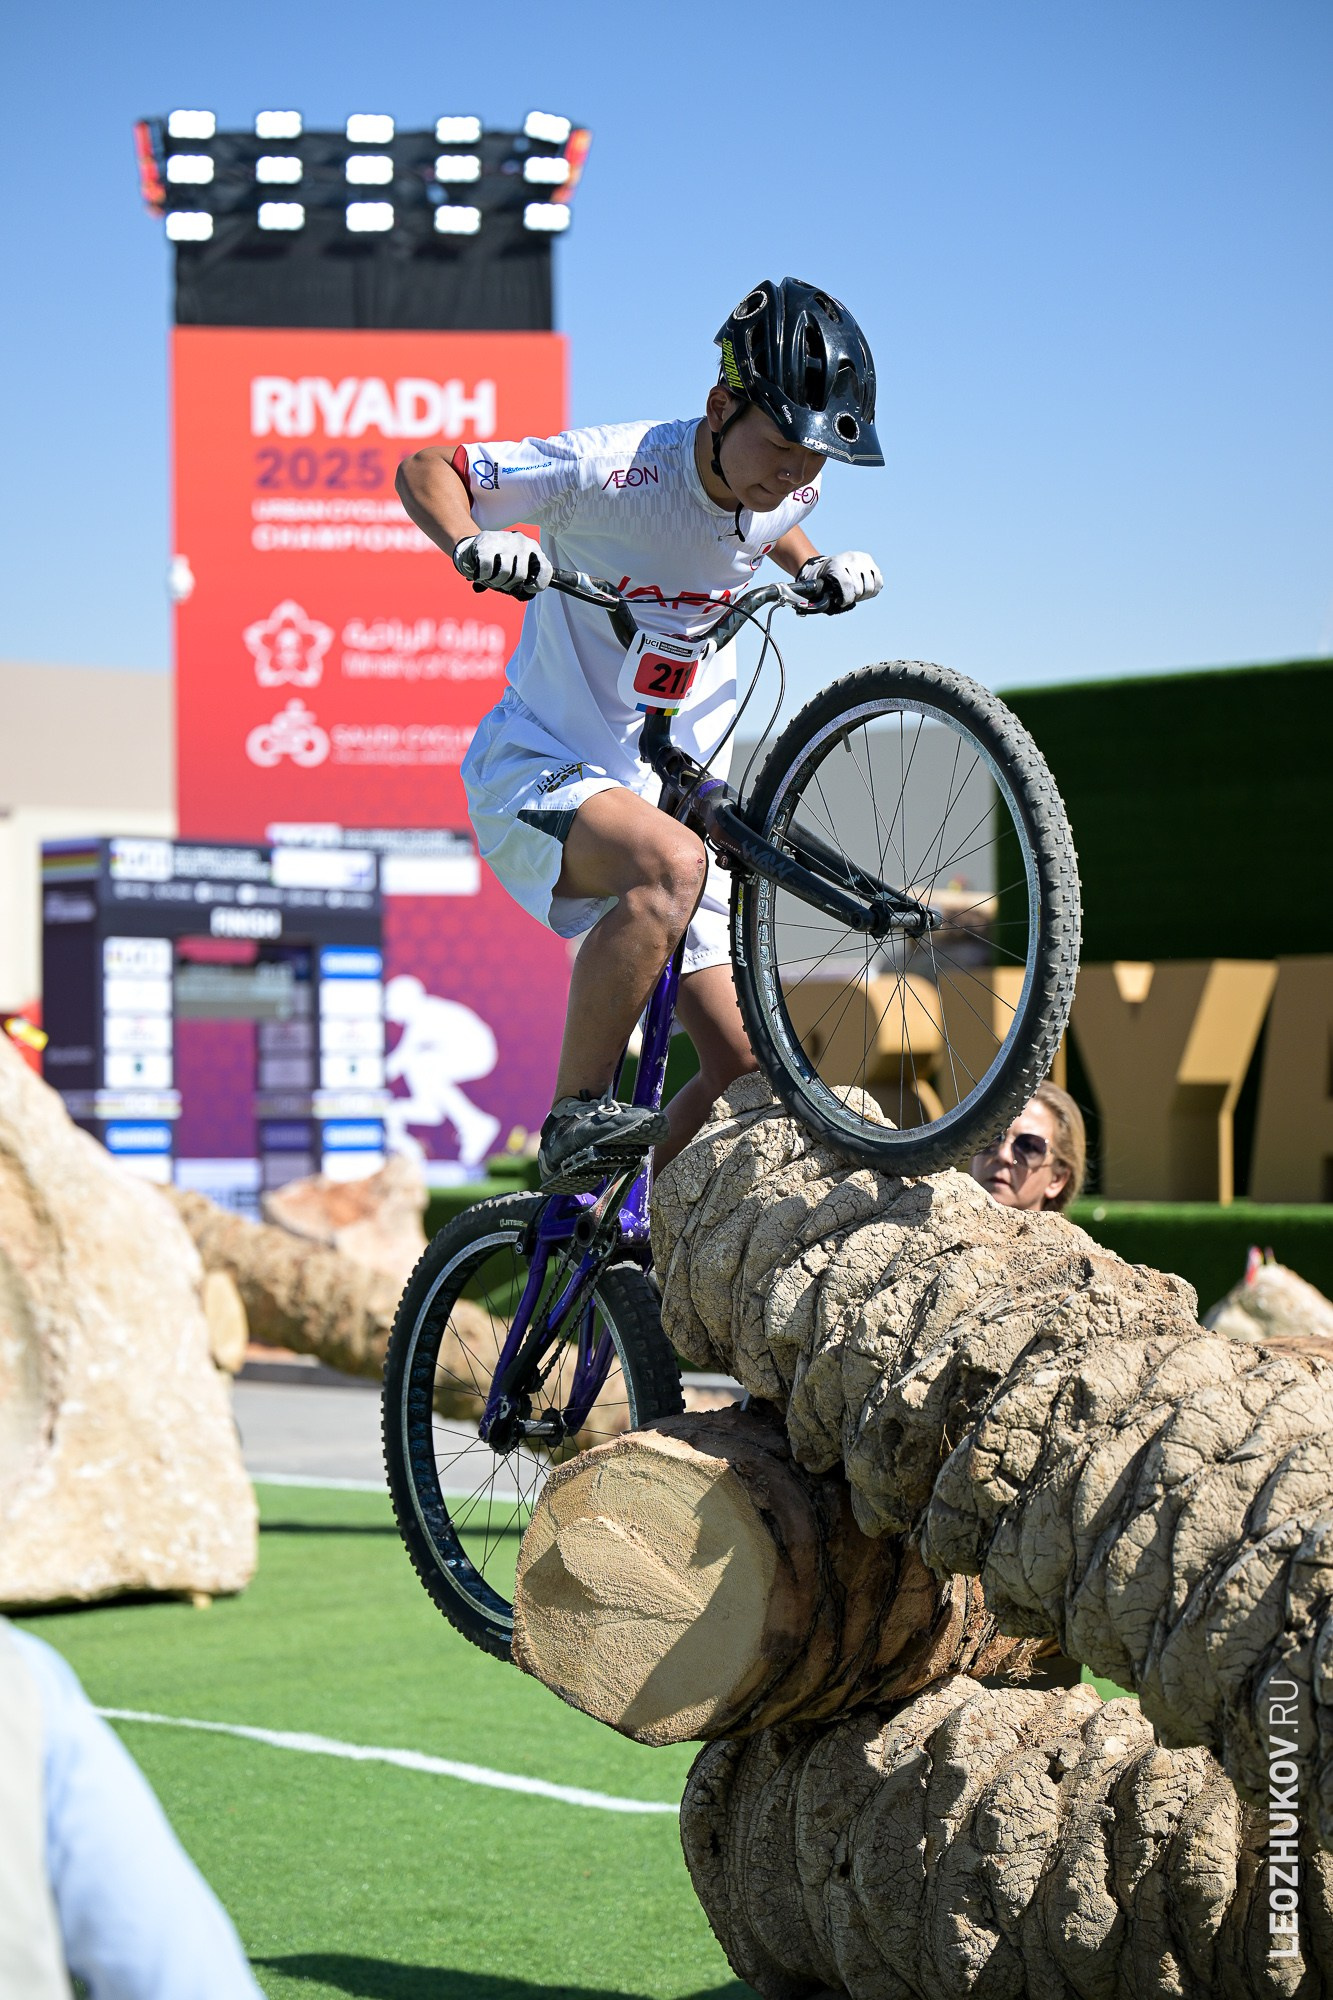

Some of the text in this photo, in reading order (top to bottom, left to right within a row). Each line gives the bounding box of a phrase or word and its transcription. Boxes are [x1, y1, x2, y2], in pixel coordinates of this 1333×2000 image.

[722, 337, 745, 389] SUPATRAIL
[250, 375, 497, 439] RIYADH
[803, 436, 829, 451] urge
[254, 447, 387, 490] 2025
[645, 638, 660, 648] UCI
